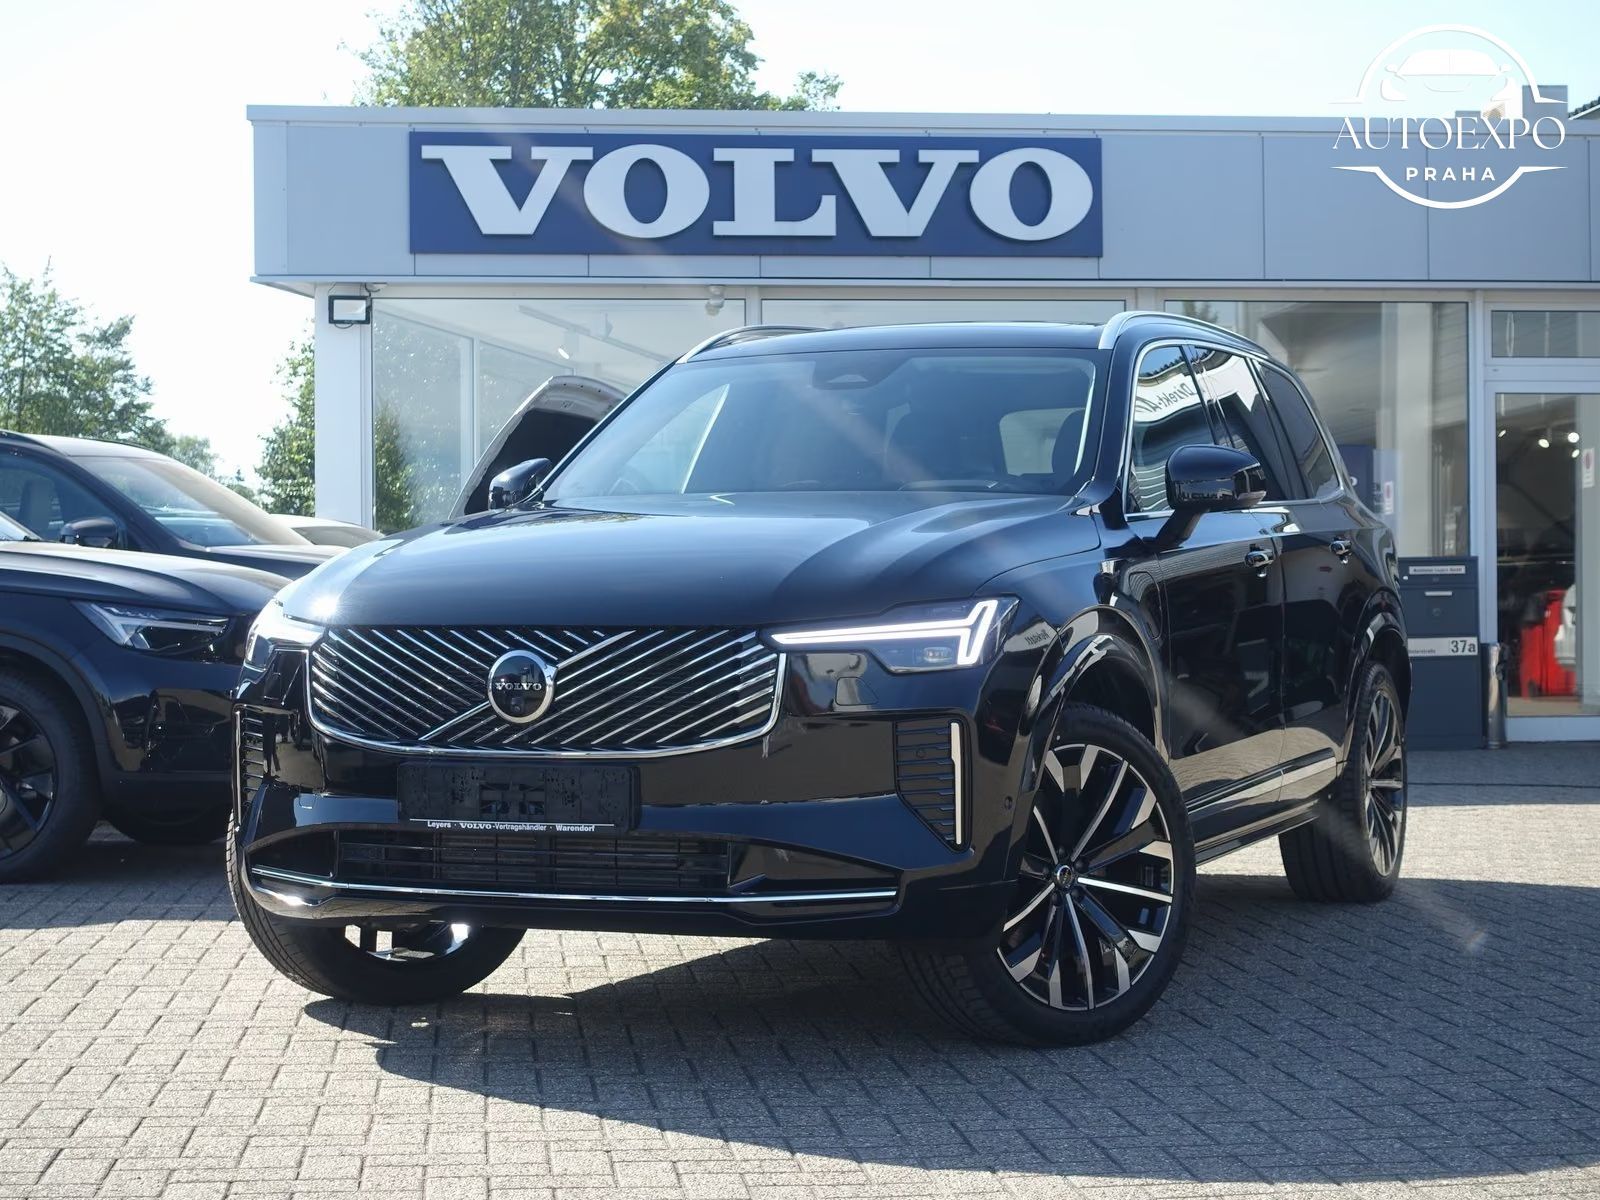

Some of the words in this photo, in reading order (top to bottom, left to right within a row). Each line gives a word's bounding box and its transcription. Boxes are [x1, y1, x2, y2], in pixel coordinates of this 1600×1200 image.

[421, 143, 1093, 241] VOLVO
[1450, 640, 1476, 653] 37a
[495, 682, 542, 691] VOLVO
[427, 820, 452, 829] Leyers
[555, 823, 596, 832] Warendorf
